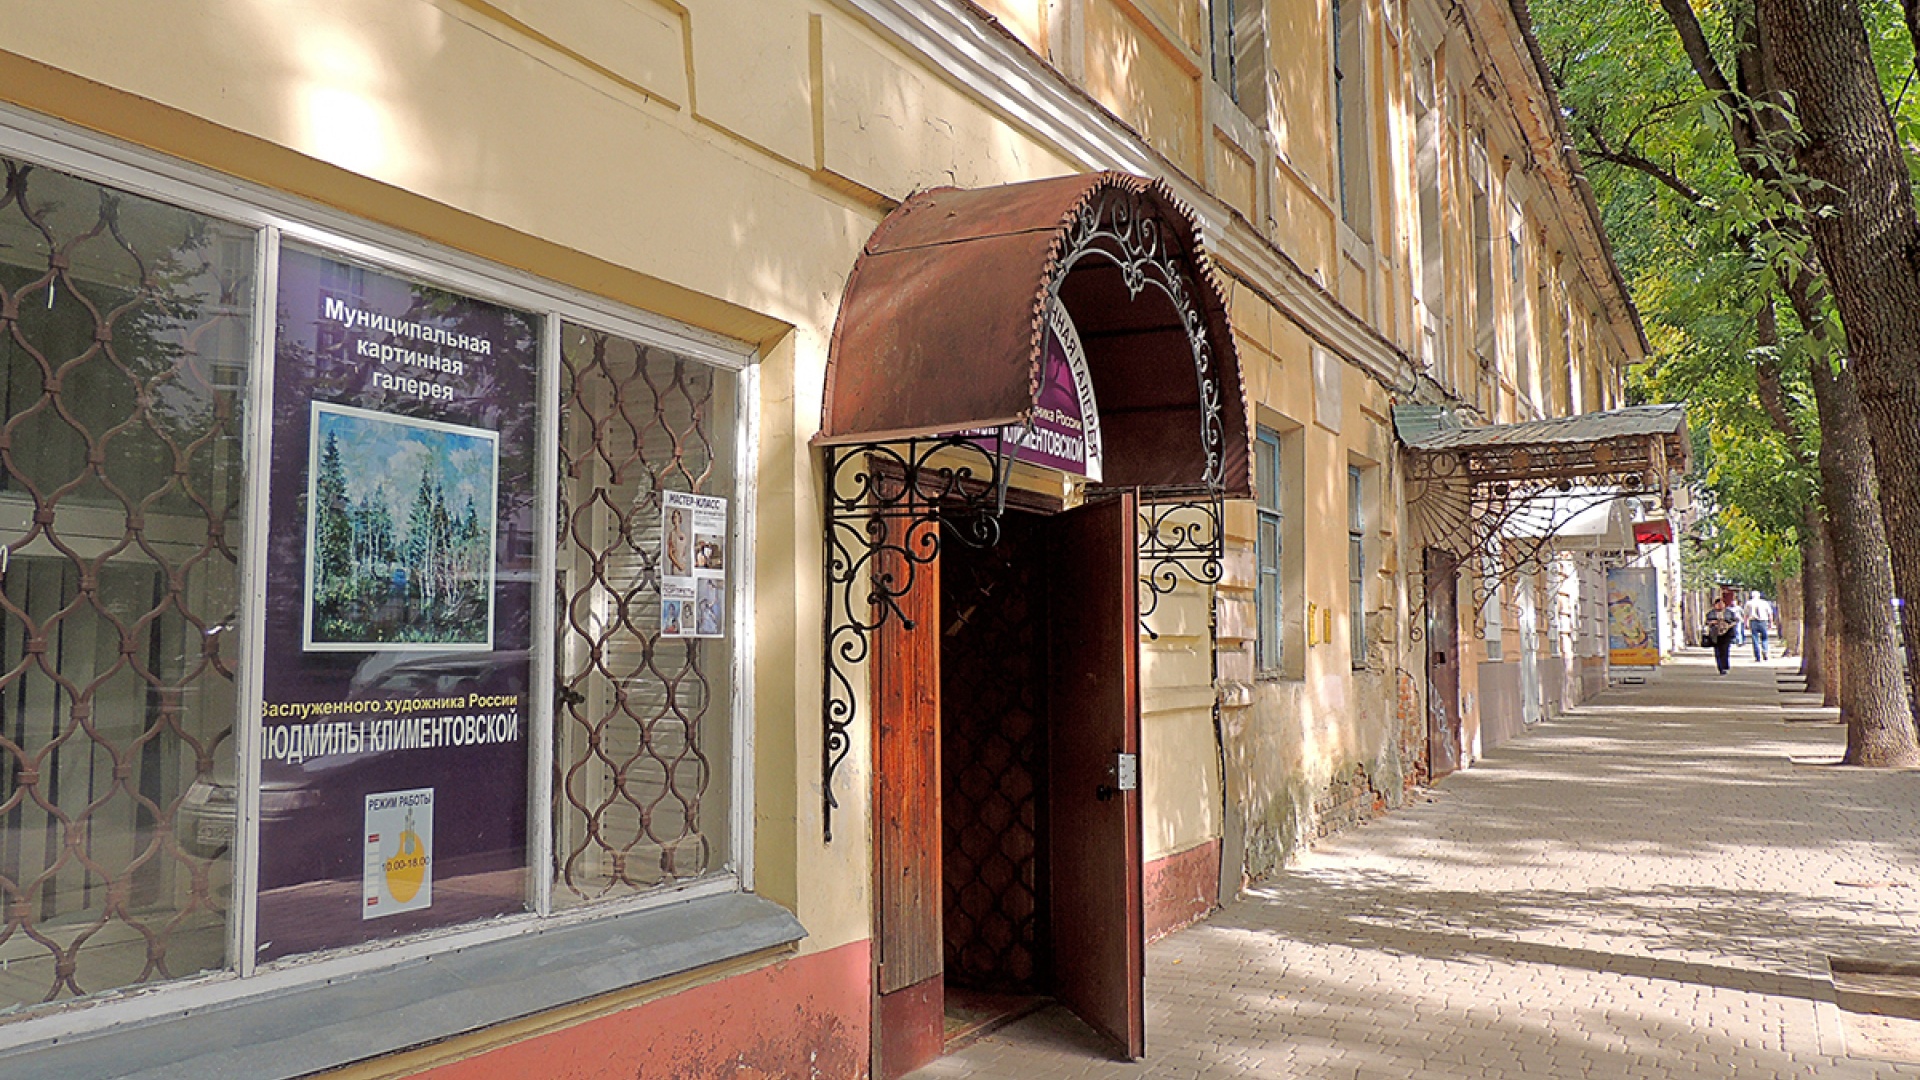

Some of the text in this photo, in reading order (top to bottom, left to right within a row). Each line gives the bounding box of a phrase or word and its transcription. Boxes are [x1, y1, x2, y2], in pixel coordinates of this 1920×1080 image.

[325, 297, 491, 355] Муниципальная
[357, 339, 463, 375] картинная
[372, 371, 454, 401] галерея
[1073, 356, 1098, 458] ГАЛЕРЕЯ
[669, 493, 720, 510] МАСТЕР-КЛАСС
[384, 696, 465, 716] художника
[469, 693, 518, 709] России
[370, 708, 518, 752] КЛИМЕНТОВСКОЙ
[368, 793, 431, 811] РЕЖИМ РАБОТЫ
[382, 856, 431, 872] 10.00-18.00
